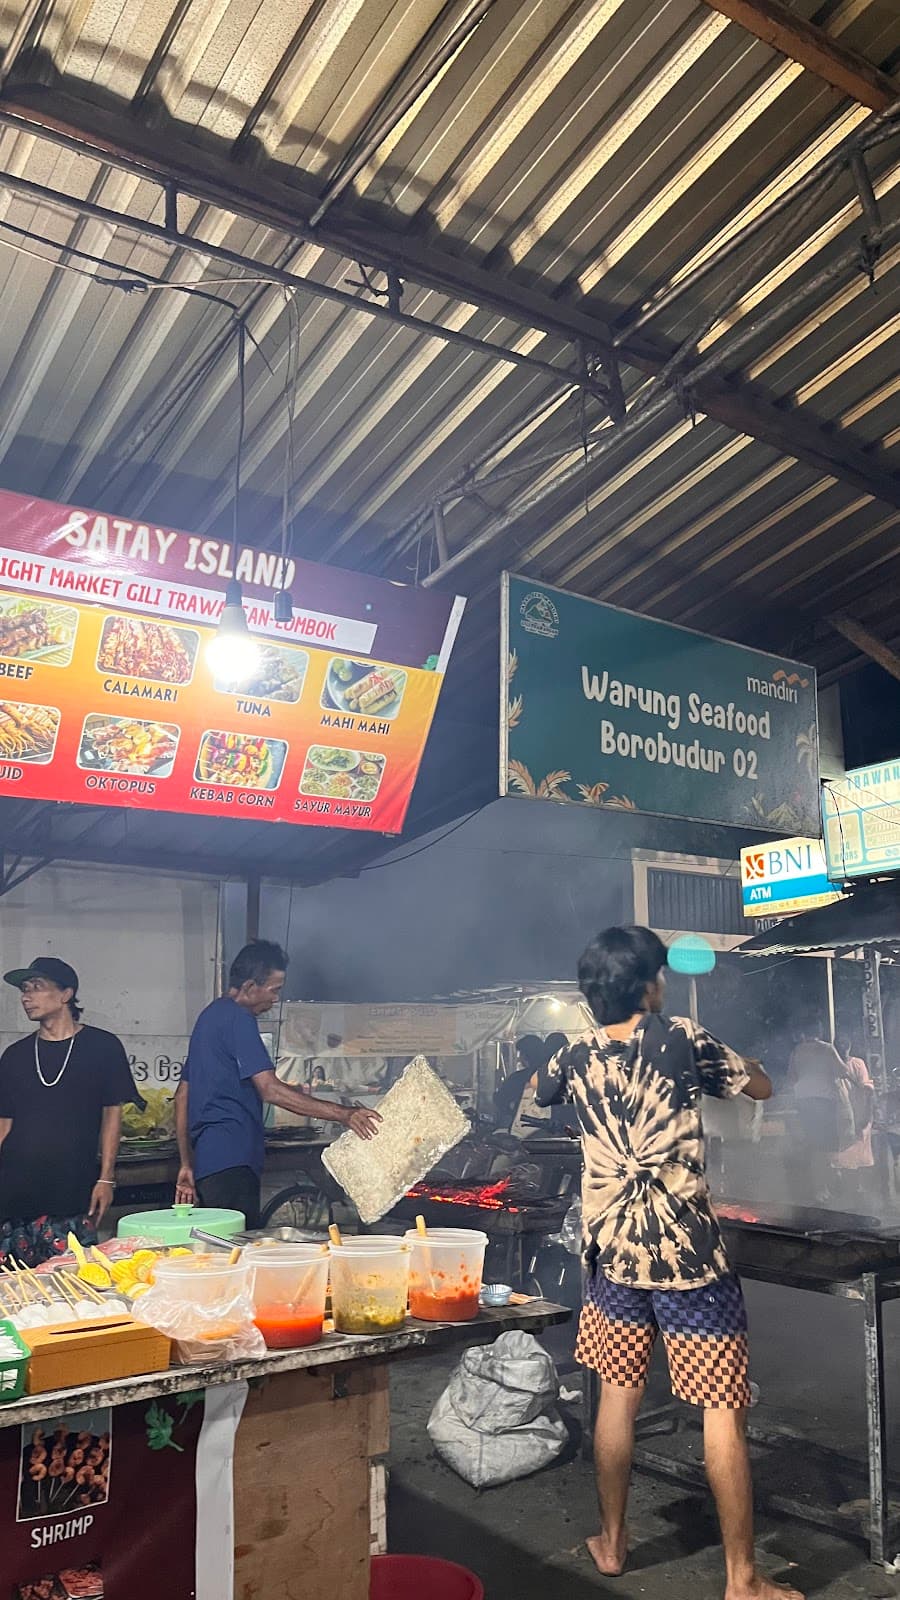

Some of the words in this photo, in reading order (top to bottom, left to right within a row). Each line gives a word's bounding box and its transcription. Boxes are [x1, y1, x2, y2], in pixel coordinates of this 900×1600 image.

[64, 511, 177, 565] SATAY
[184, 536, 296, 590] ISLAND
[50, 567, 123, 598] MARKET
[126, 583, 162, 606] GILI
[0, 662, 33, 680] BEEF
[104, 679, 178, 702] CALAMARI
[746, 676, 798, 704] mandiri
[236, 700, 271, 717] TUNA
[580, 666, 680, 730] Warung
[687, 692, 770, 740] Seafood
[320, 715, 355, 730] MAHI
[357, 721, 390, 735] MAHI
[600, 719, 726, 774] Borobudur
[732, 748, 758, 780] 02
[86, 775, 156, 794] OKTOPUS
[190, 788, 233, 804] KEBAB
[238, 793, 275, 807] CORN
[294, 800, 331, 813] SAYUR
[333, 804, 371, 817] MAYUR
[768, 844, 811, 876] BNI
[750, 886, 772, 901] ATM
[30, 1514, 94, 1549] SHRIMP
